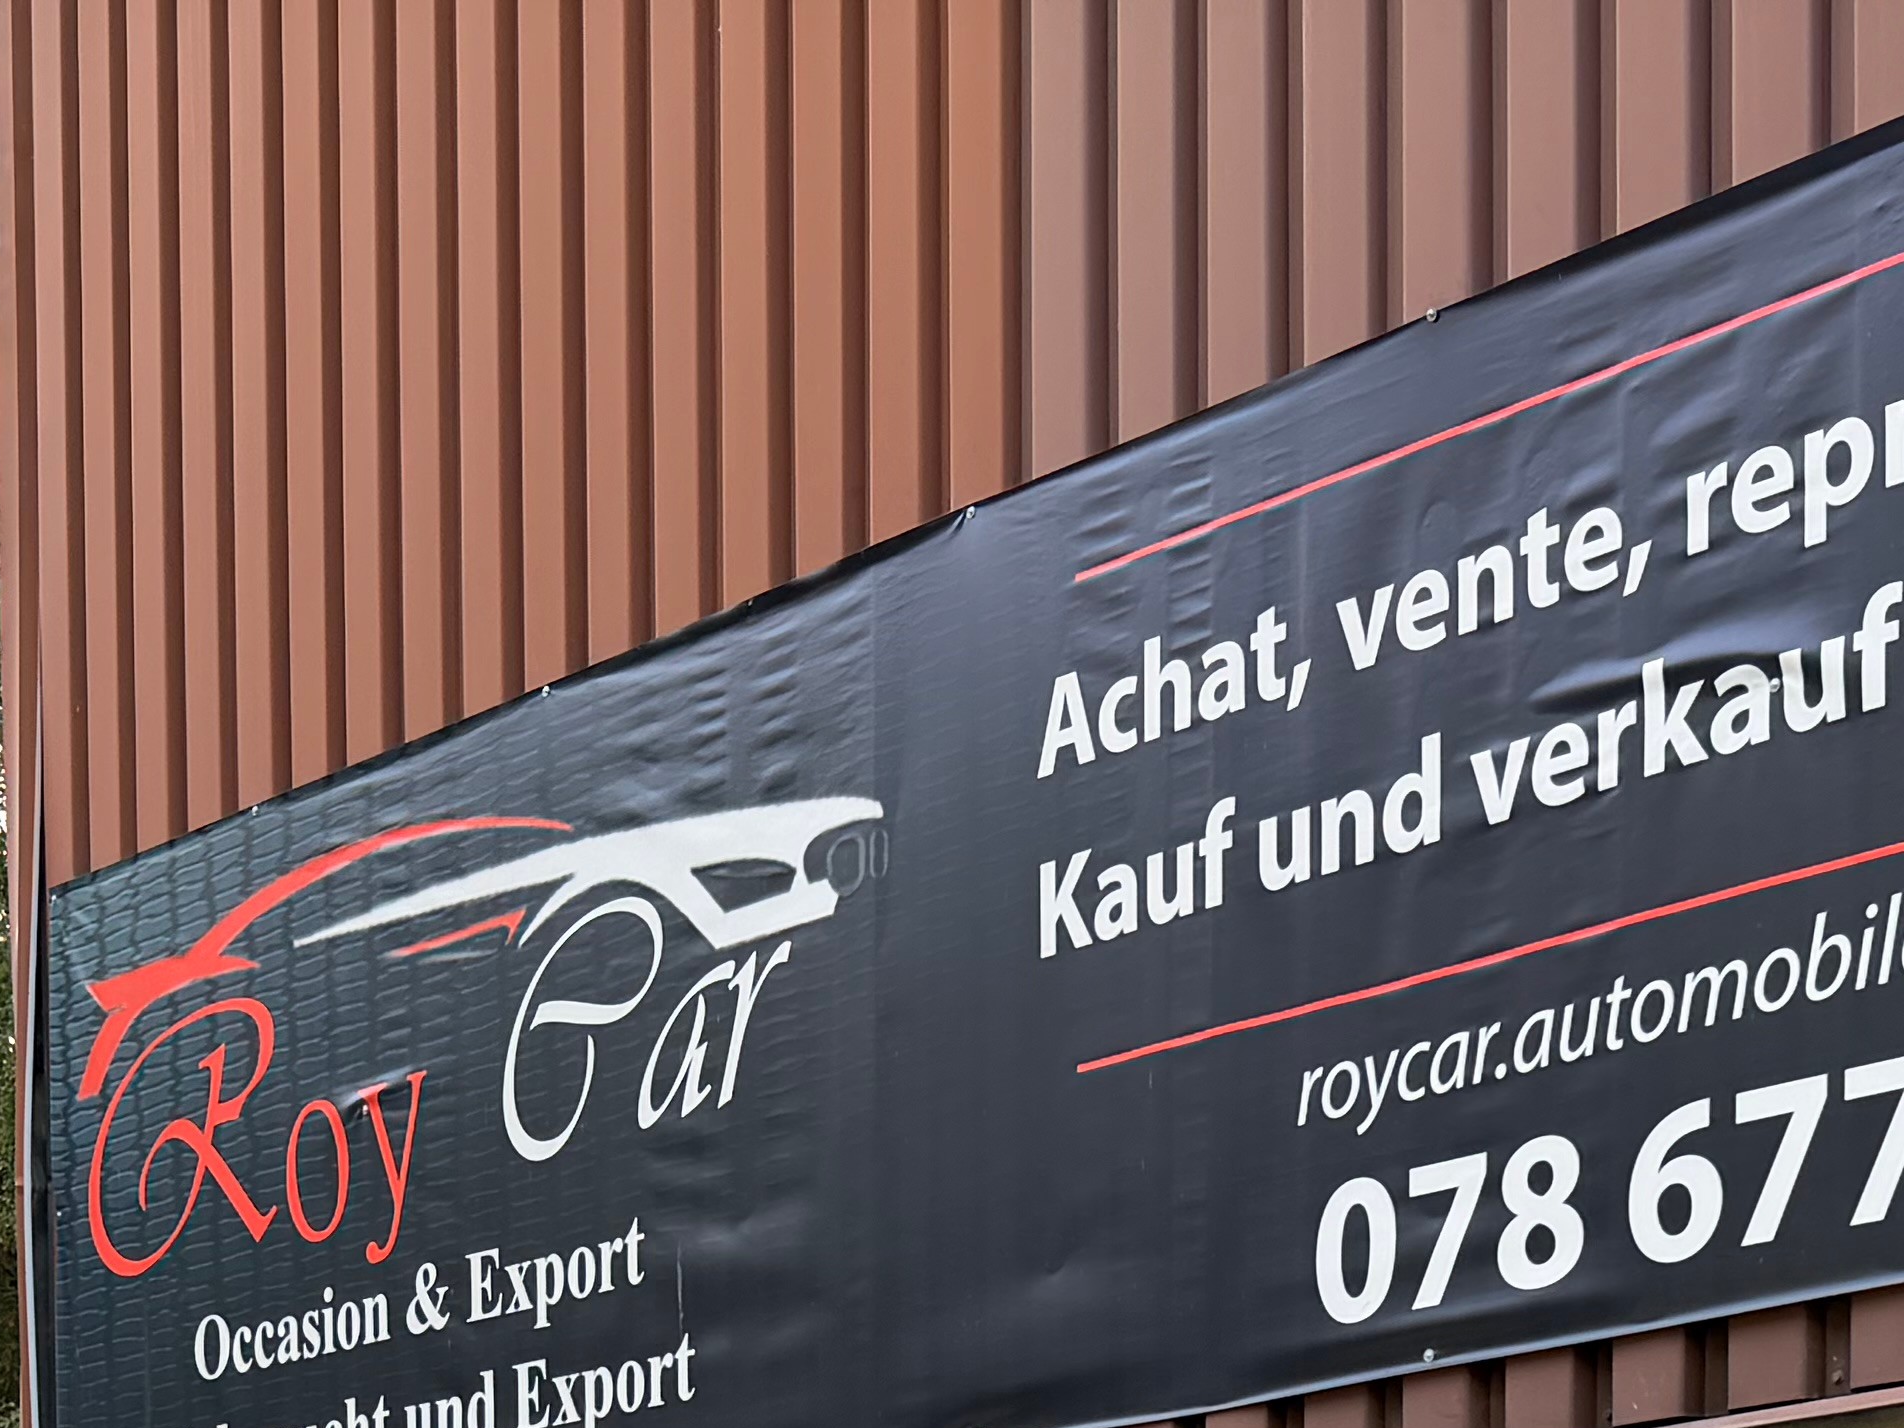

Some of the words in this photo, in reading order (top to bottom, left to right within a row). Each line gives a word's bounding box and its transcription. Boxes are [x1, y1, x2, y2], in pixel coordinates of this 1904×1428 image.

[1035, 606, 1312, 780] Achat,
[1335, 506, 1653, 671] vente,
[1039, 795, 1238, 959] Kauf
[1258, 731, 1442, 892] und
[1469, 580, 1904, 826] verkauf
[88, 997, 427, 1278] Roy
[502, 896, 792, 1162] Car
[194, 1286, 391, 1380] Occasion
[405, 1262, 451, 1335] &
[464, 1216, 646, 1330] Export
[1315, 1134, 1585, 1325] 078
